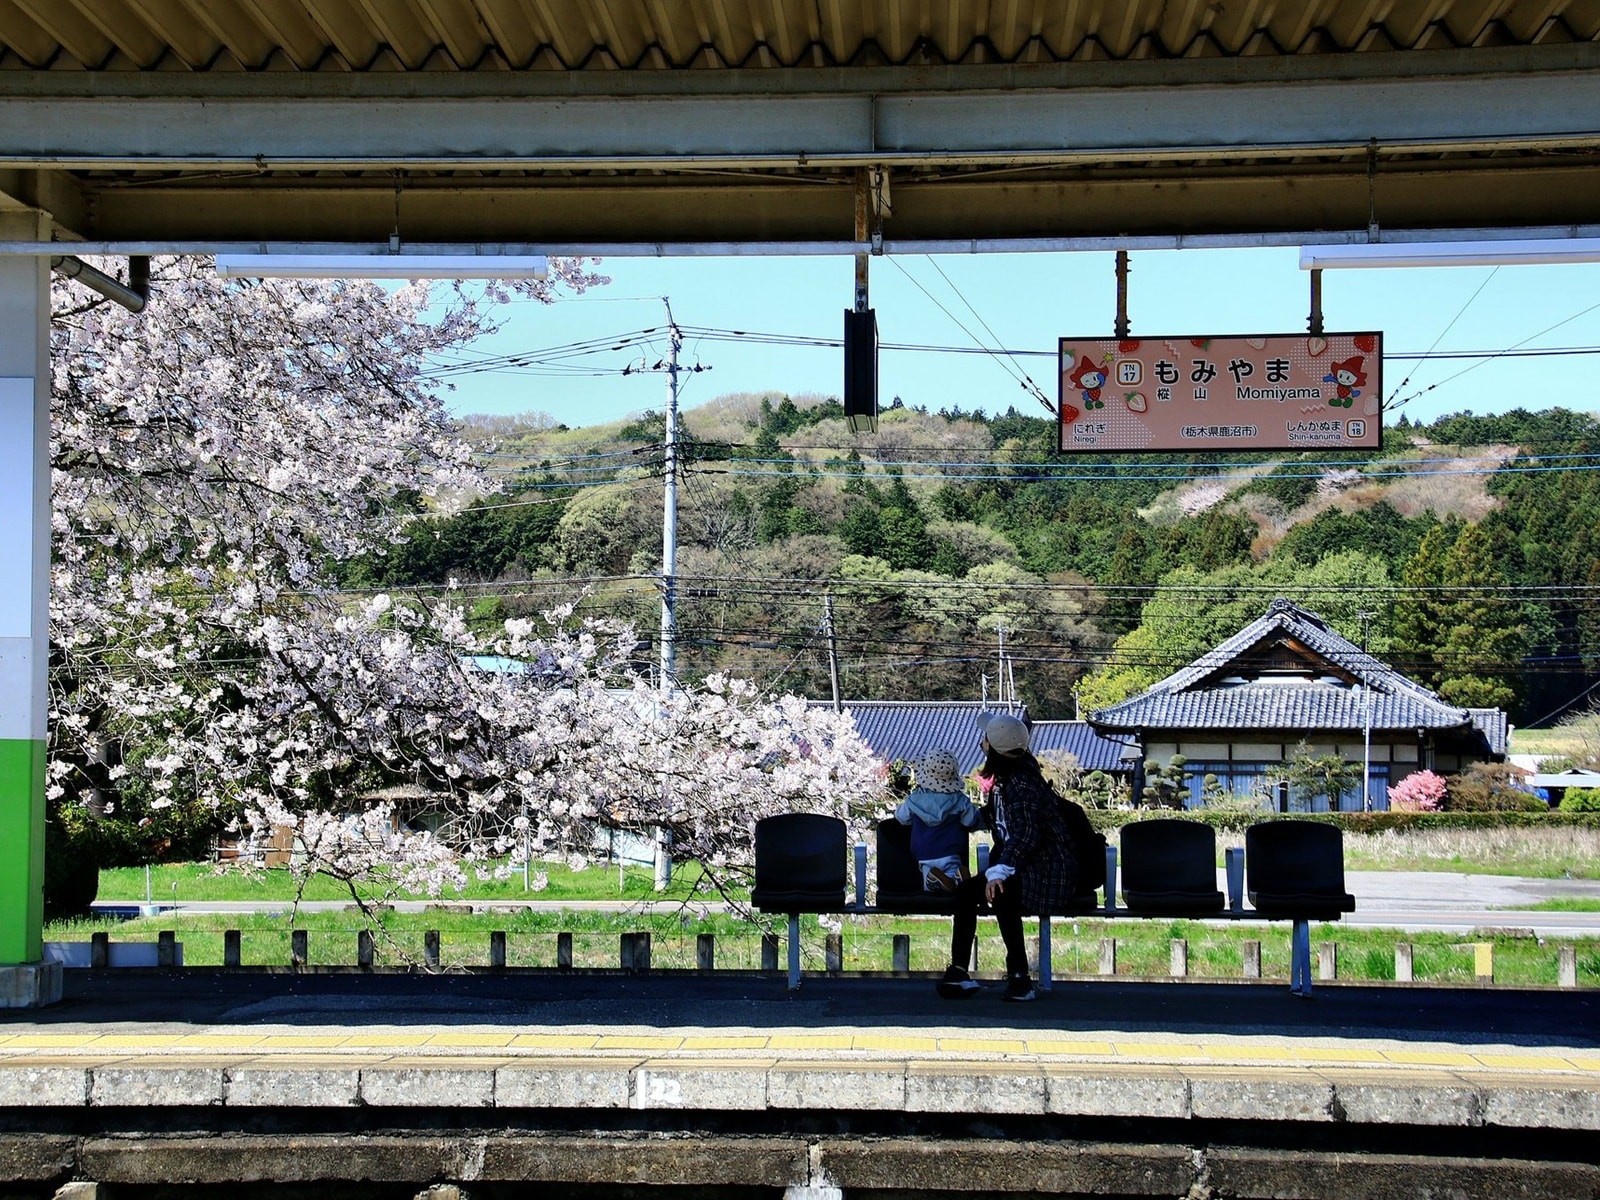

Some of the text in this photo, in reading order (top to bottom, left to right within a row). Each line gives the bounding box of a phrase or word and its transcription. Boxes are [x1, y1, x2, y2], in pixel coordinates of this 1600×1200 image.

[1123, 372, 1136, 381] 17
[1154, 358, 1291, 384] もみやま
[1237, 387, 1321, 401] Momiyama
[1074, 423, 1107, 434] にれぎ
[1286, 420, 1341, 432] しんかぬま
[1073, 435, 1097, 443] Niregi
[1288, 433, 1341, 441] Shin-kanuma
